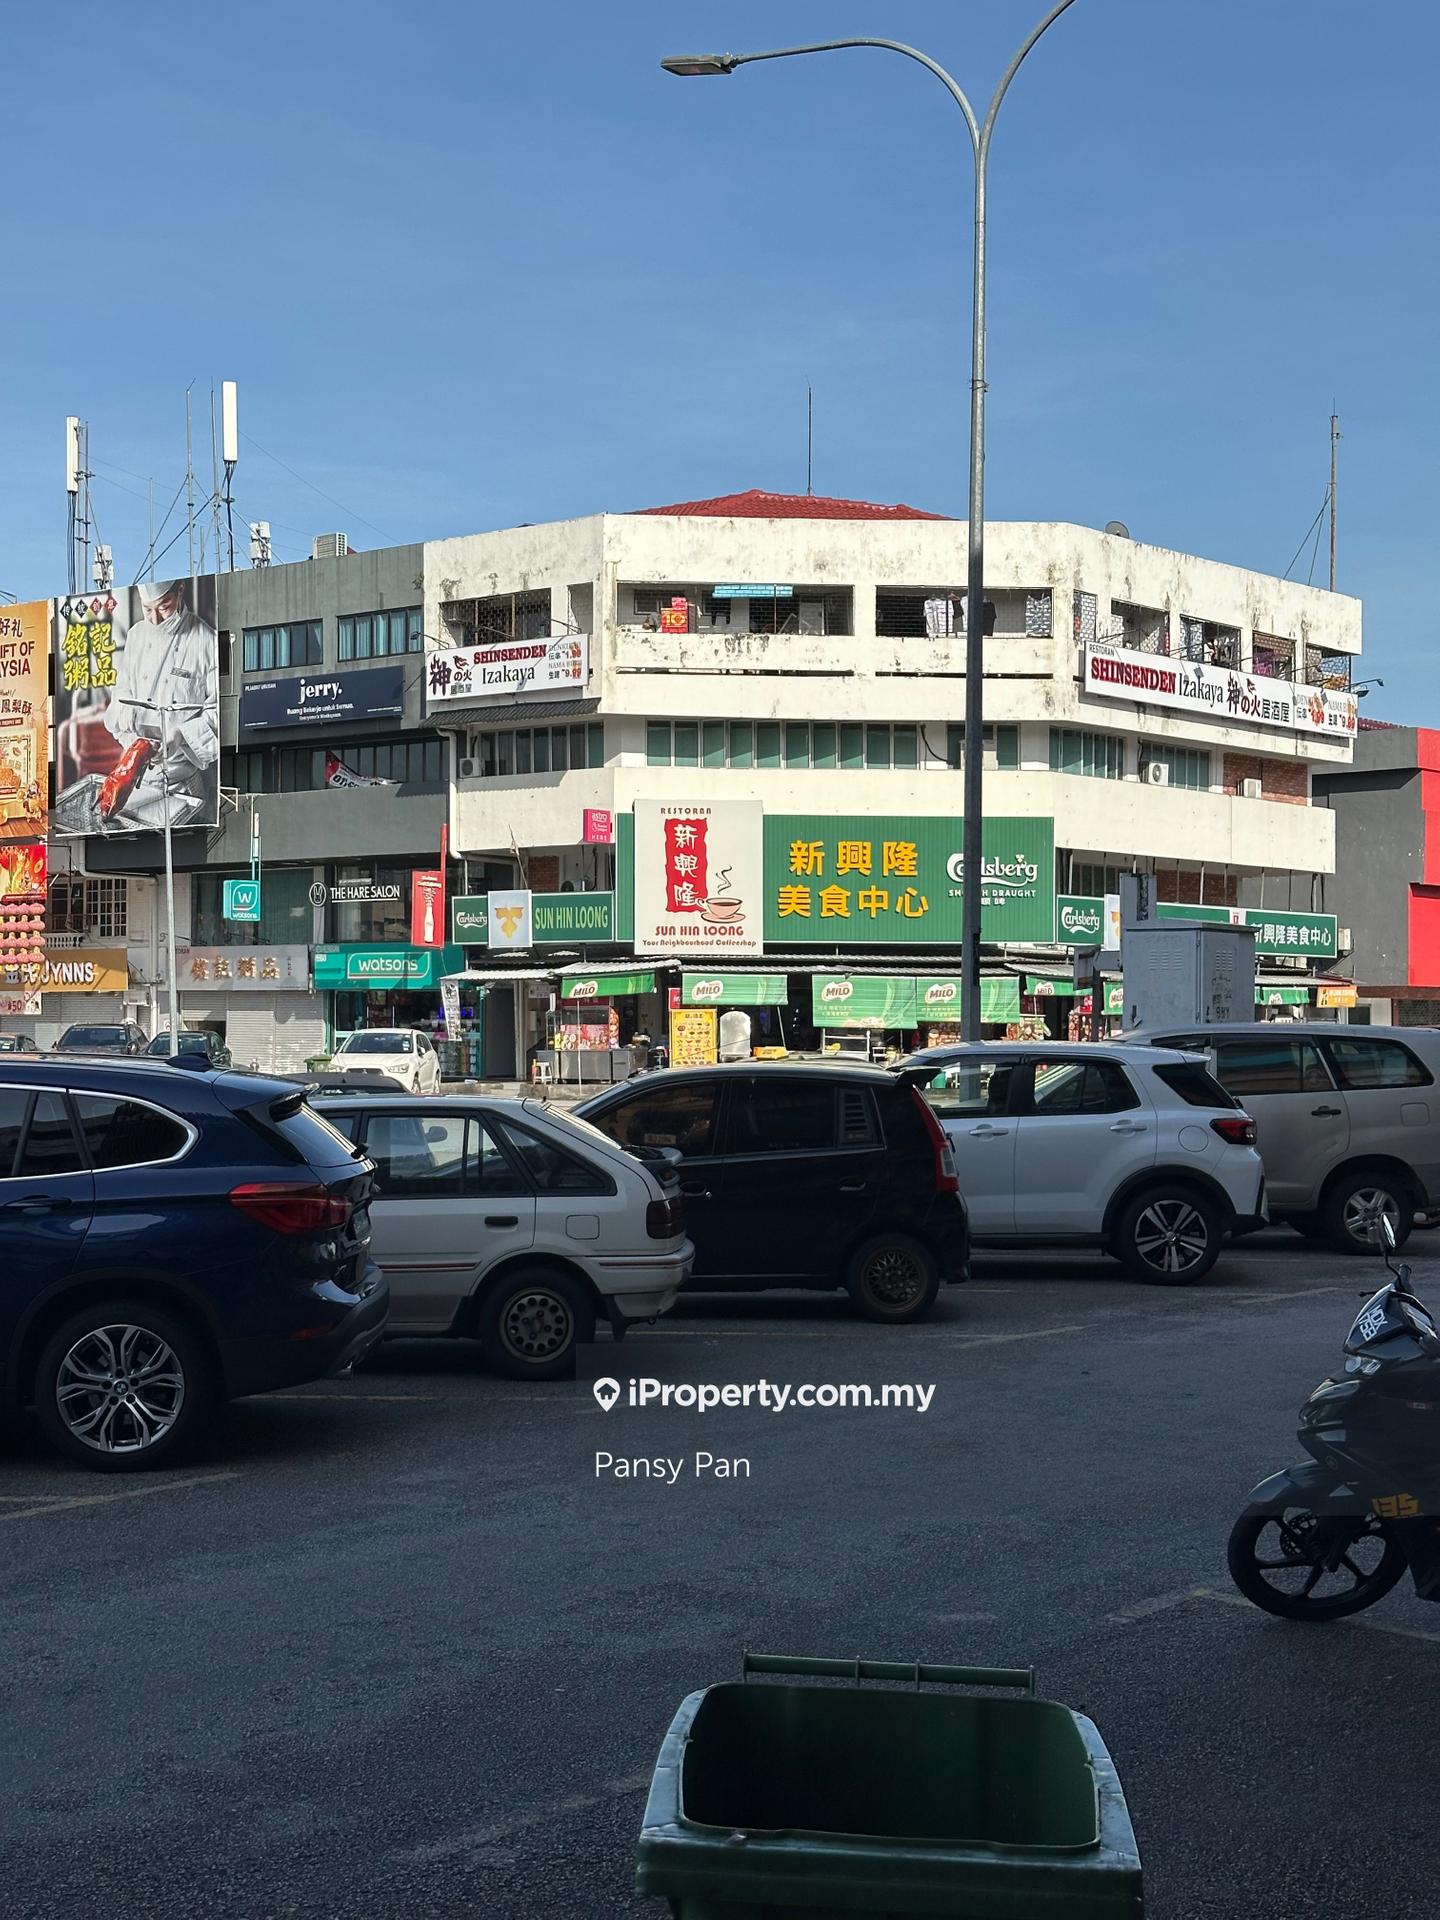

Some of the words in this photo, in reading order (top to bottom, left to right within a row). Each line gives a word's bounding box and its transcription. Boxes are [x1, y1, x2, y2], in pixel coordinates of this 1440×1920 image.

[20, 641, 35, 656] OF
[473, 644, 547, 665] SHINSENDEN
[1089, 644, 1115, 657] RESTORAN
[482, 664, 535, 686] Izakaya
[1091, 656, 1177, 695] SHINSENDEN
[1179, 672, 1224, 708] Izakaya
[660, 807, 712, 815] RESTORAN
[673, 823, 699, 907] 新興隆
[789, 841, 918, 877] 新興隆
[946, 853, 1038, 887] Clsberg
[330, 886, 346, 899] THE
[347, 885, 370, 899] HARE
[370, 884, 400, 898] SALON
[992, 889, 1037, 897] DRAUGHT
[778, 885, 929, 920] 美食中心
[456, 911, 487, 928] Carlsberg
[535, 907, 553, 929] SUN
[556, 907, 573, 928] HIN
[575, 905, 608, 928] LOONG
[1061, 906, 1101, 934] Carlsberg
[655, 926, 676, 936] SUN
[680, 926, 700, 936] HIN
[703, 926, 744, 936] LOONG
[660, 939, 714, 947] Neighbourhood
[715, 939, 757, 947] Coffeeshop
[358, 957, 418, 971] watsons
[41, 960, 94, 984] JYNNS
[573, 986, 595, 997] MILO
[696, 985, 720, 996] MILO
[825, 987, 850, 997] MILO
[929, 988, 954, 999] MILO
